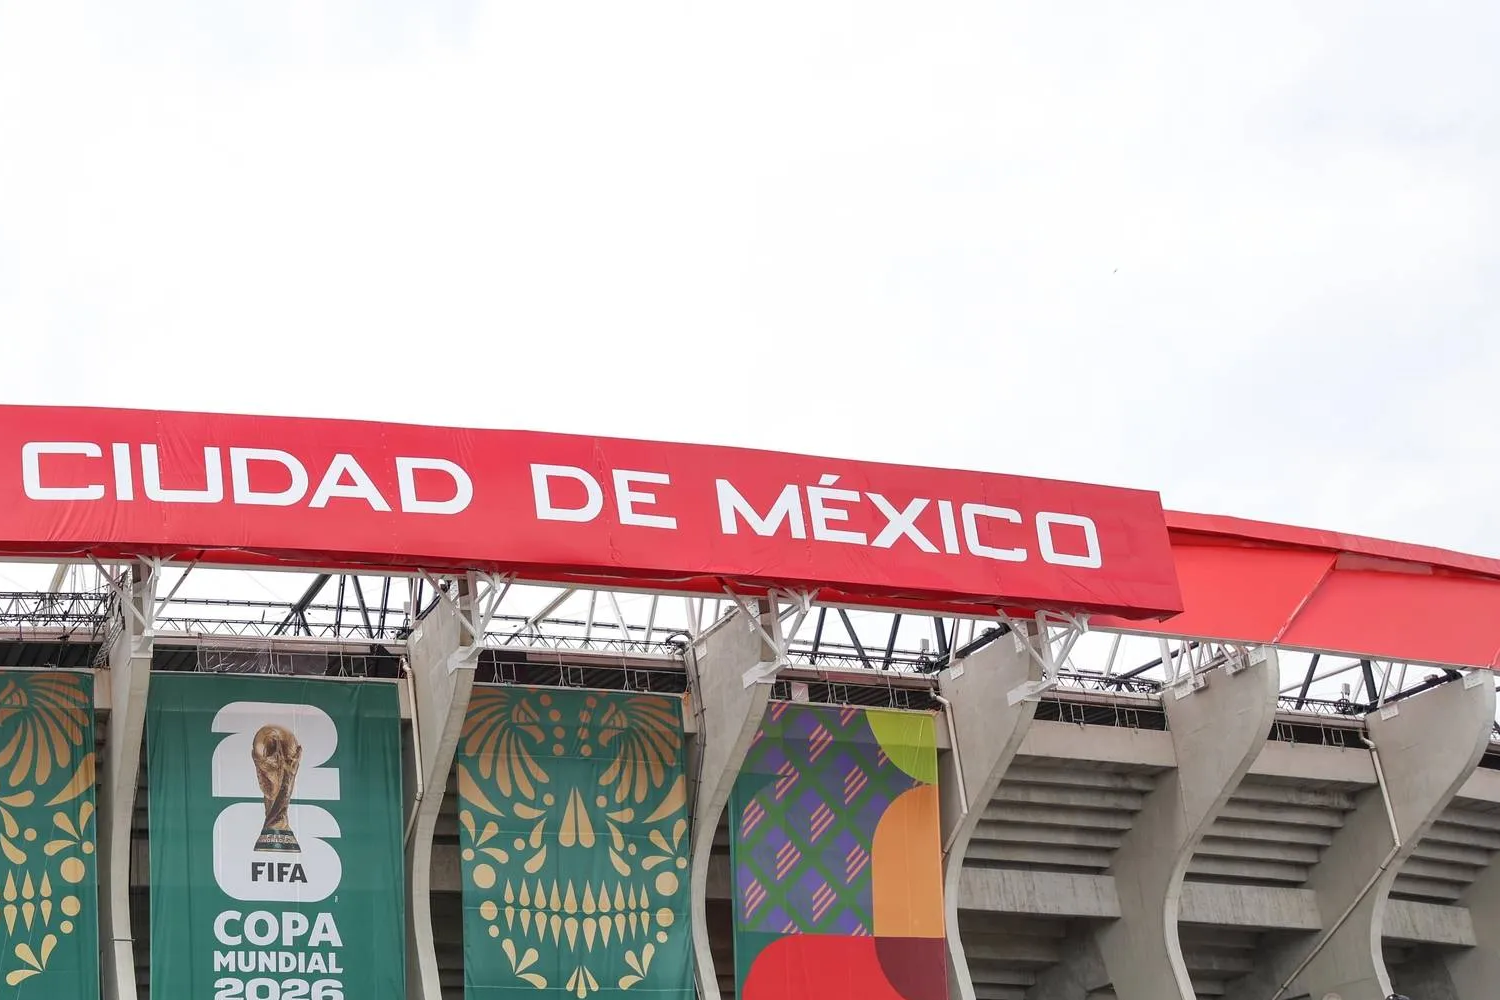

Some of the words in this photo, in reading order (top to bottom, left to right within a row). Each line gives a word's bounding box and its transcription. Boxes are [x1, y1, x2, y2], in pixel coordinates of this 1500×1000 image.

[22, 441, 474, 516] CIUDAD
[530, 462, 678, 530] DE
[715, 473, 1102, 569] MÉXICO
[251, 861, 308, 884] FIFA
[213, 910, 343, 947] COPA
[213, 950, 344, 974] MUNDIAL
